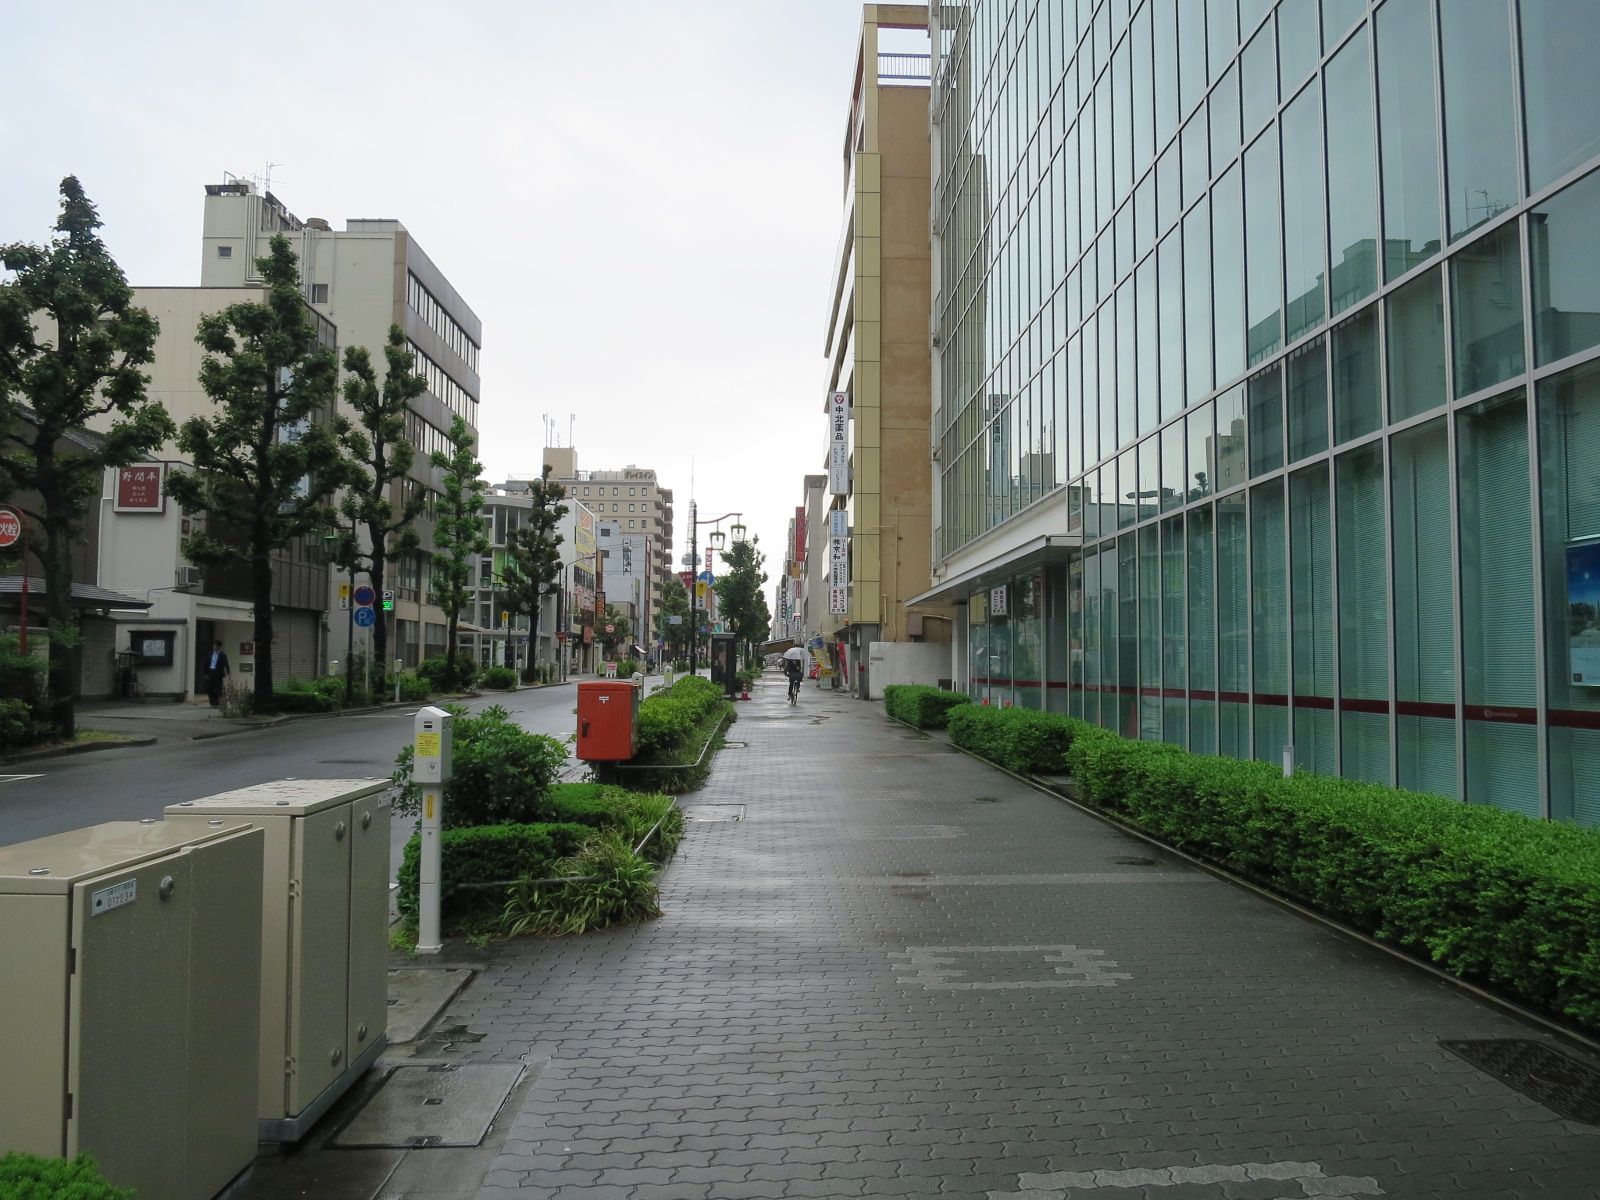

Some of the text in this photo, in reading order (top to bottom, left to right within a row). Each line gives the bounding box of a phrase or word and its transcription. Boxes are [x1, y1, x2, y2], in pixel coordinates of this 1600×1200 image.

[835, 405, 844, 441] 中北薬品
[358, 611, 367, 624] P
